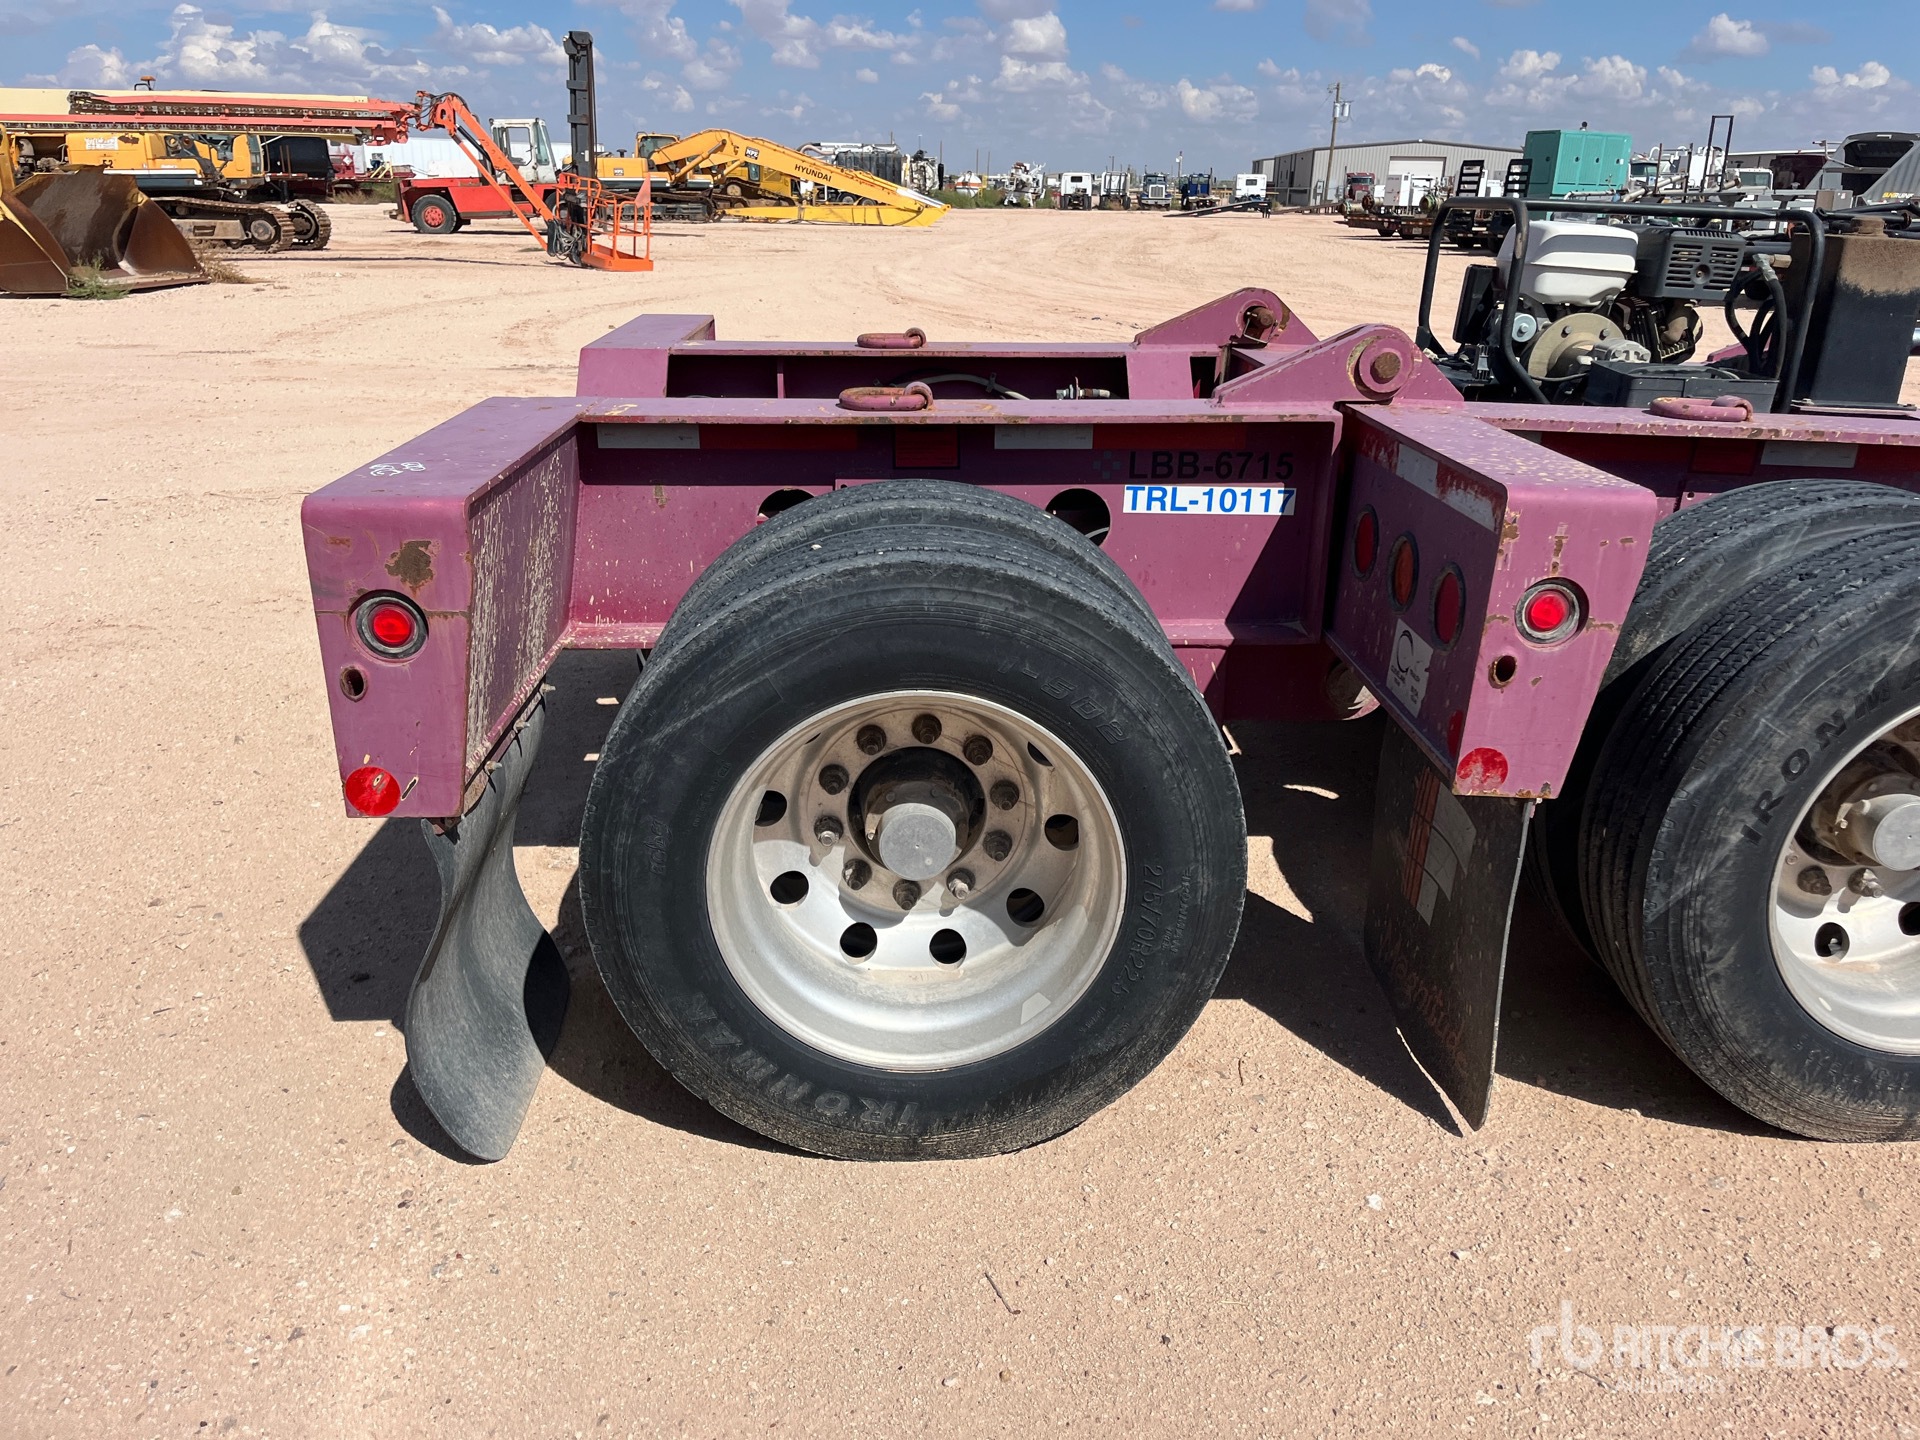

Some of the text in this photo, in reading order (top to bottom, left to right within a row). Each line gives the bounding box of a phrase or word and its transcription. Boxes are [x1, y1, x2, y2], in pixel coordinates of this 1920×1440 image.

[794, 163, 832, 183] HYUNDAI
[1128, 451, 1294, 480] LBB-6715
[1126, 486, 1295, 513] TRL-10117
[672, 990, 919, 1127] IRONMAN
